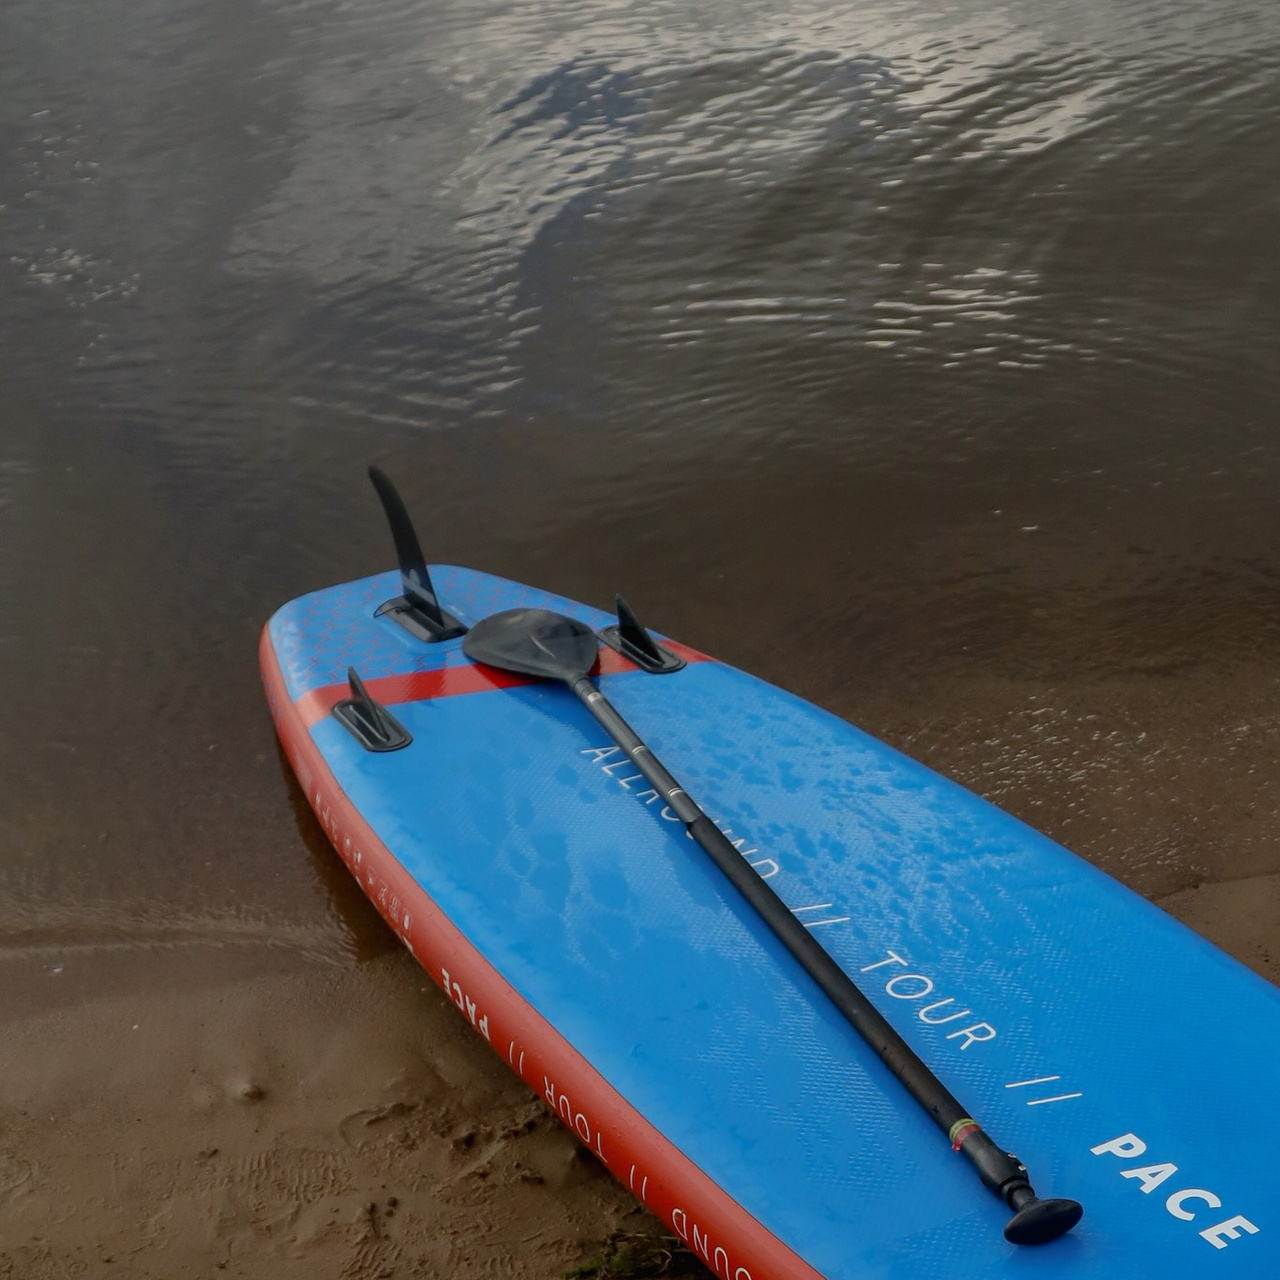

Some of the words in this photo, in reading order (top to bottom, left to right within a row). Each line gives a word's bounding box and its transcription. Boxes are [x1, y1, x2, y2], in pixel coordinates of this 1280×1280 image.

[441, 968, 491, 1041] PACE
[545, 1076, 608, 1162] TOUR
[860, 949, 997, 1052] TOUR
[1090, 1132, 1261, 1250] PACE
